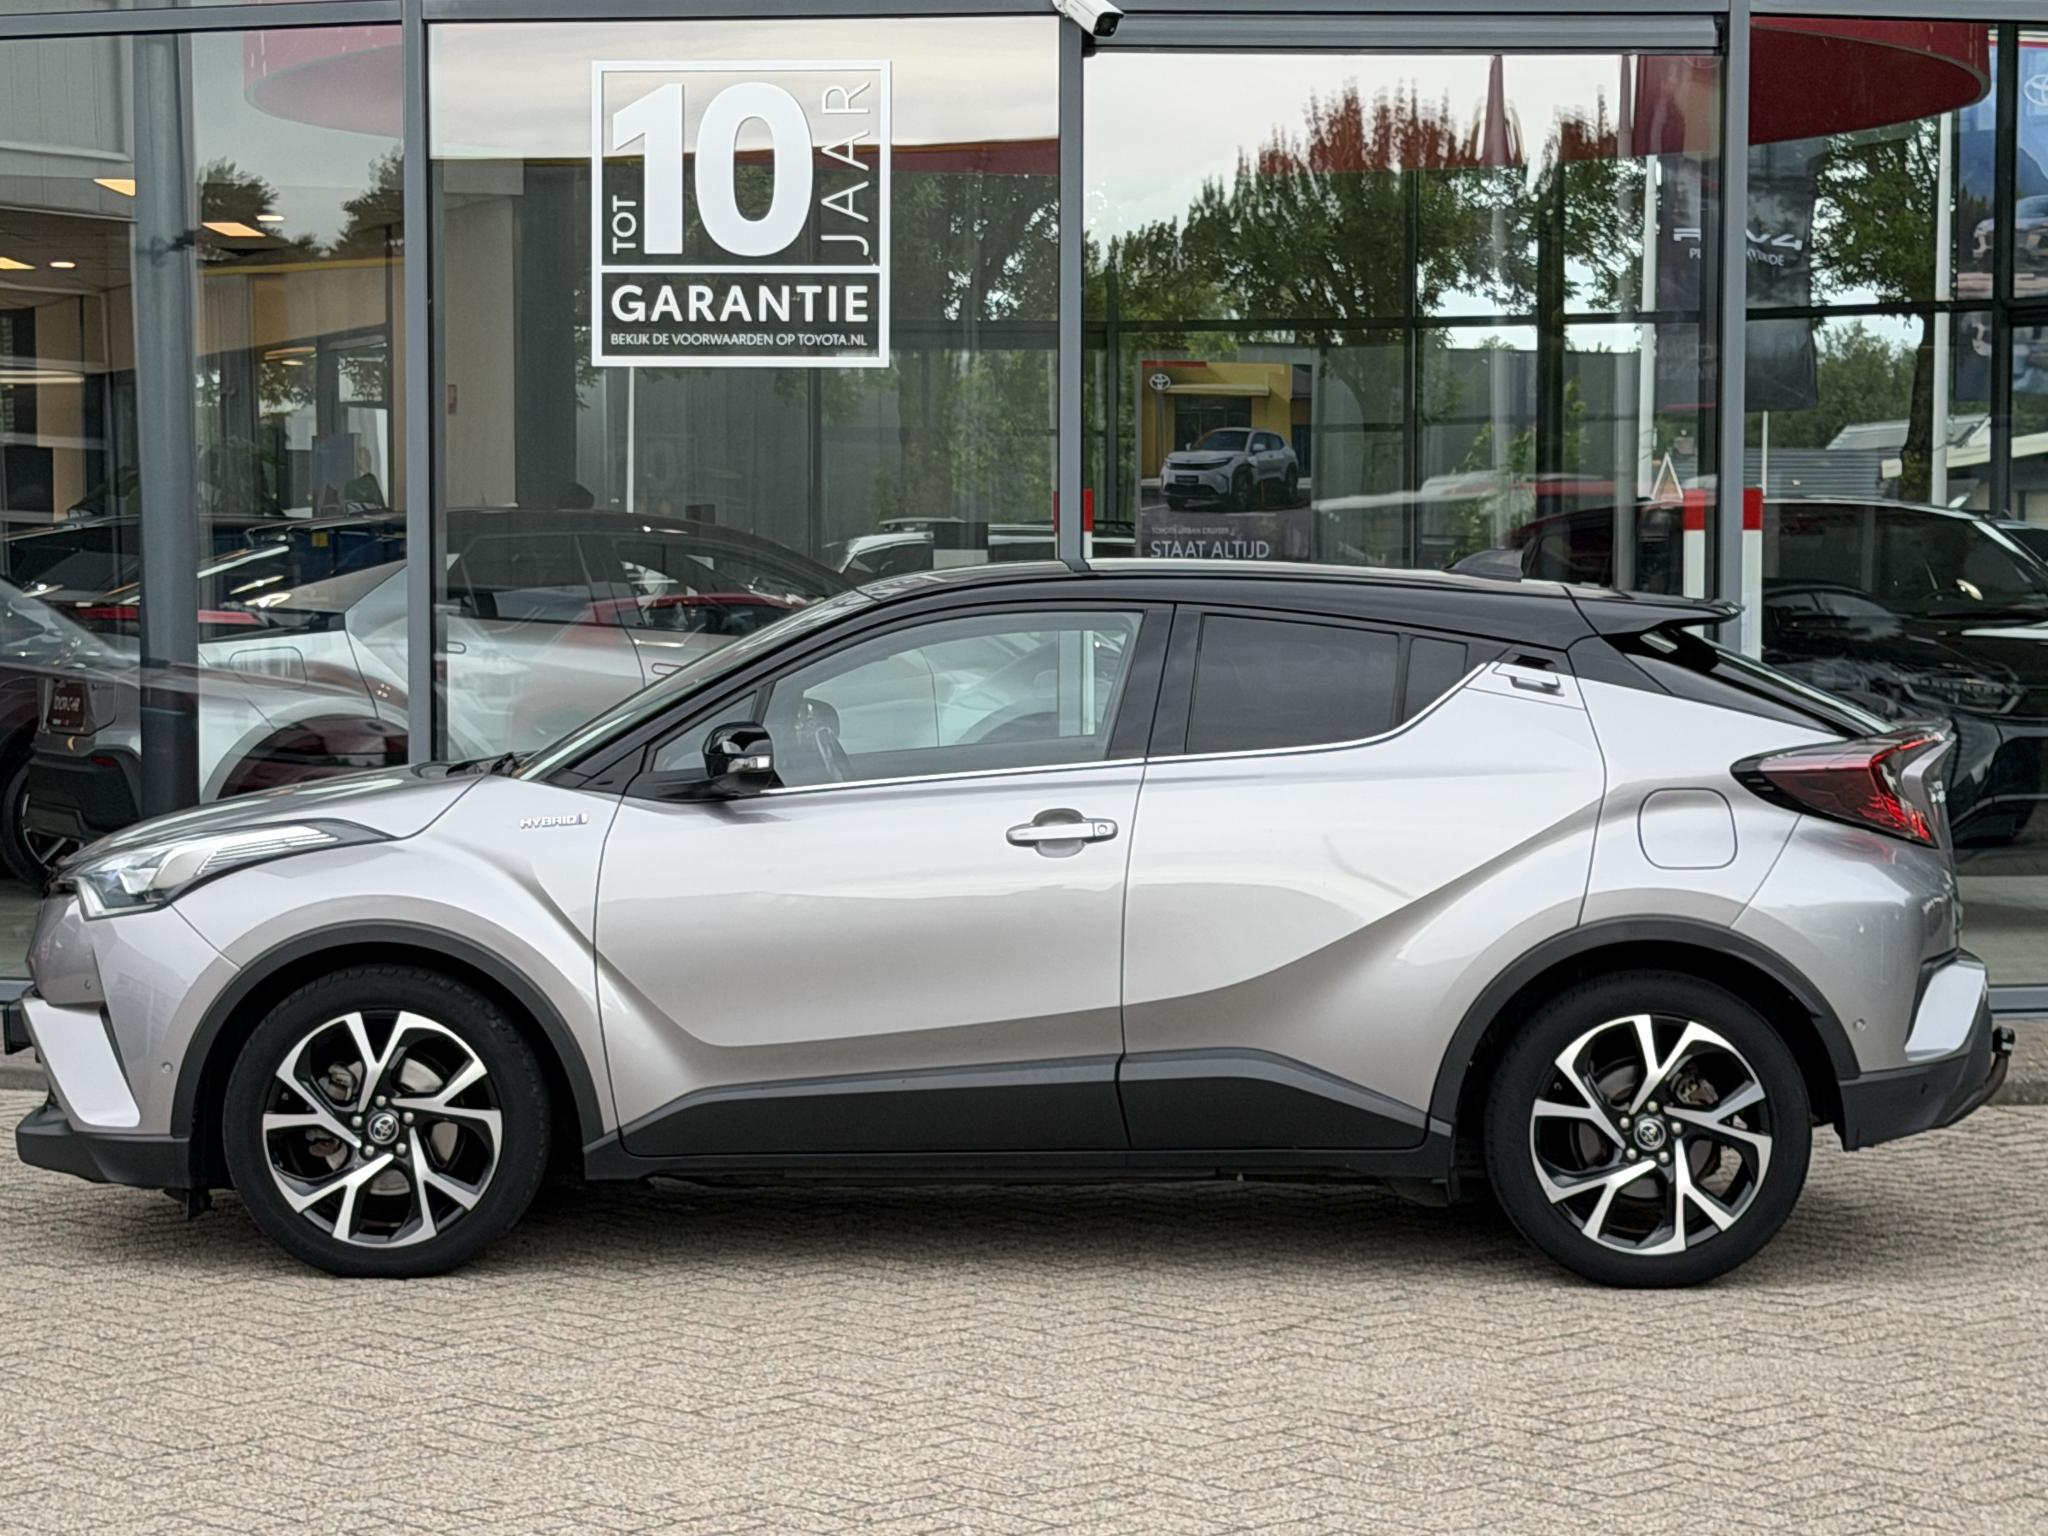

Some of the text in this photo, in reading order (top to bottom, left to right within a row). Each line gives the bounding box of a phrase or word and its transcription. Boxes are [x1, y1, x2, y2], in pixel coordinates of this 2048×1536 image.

[612, 81, 813, 257] 10
[820, 81, 871, 256] JAAR
[612, 195, 637, 255] TOT
[611, 284, 869, 322] GARANTIE
[610, 333, 868, 346] BEKIJK DE VOORWAARDEN OP TOYOTA.NL
[1150, 540, 1270, 558] STAAT ALTIJD
[520, 815, 577, 828] HYBRID
